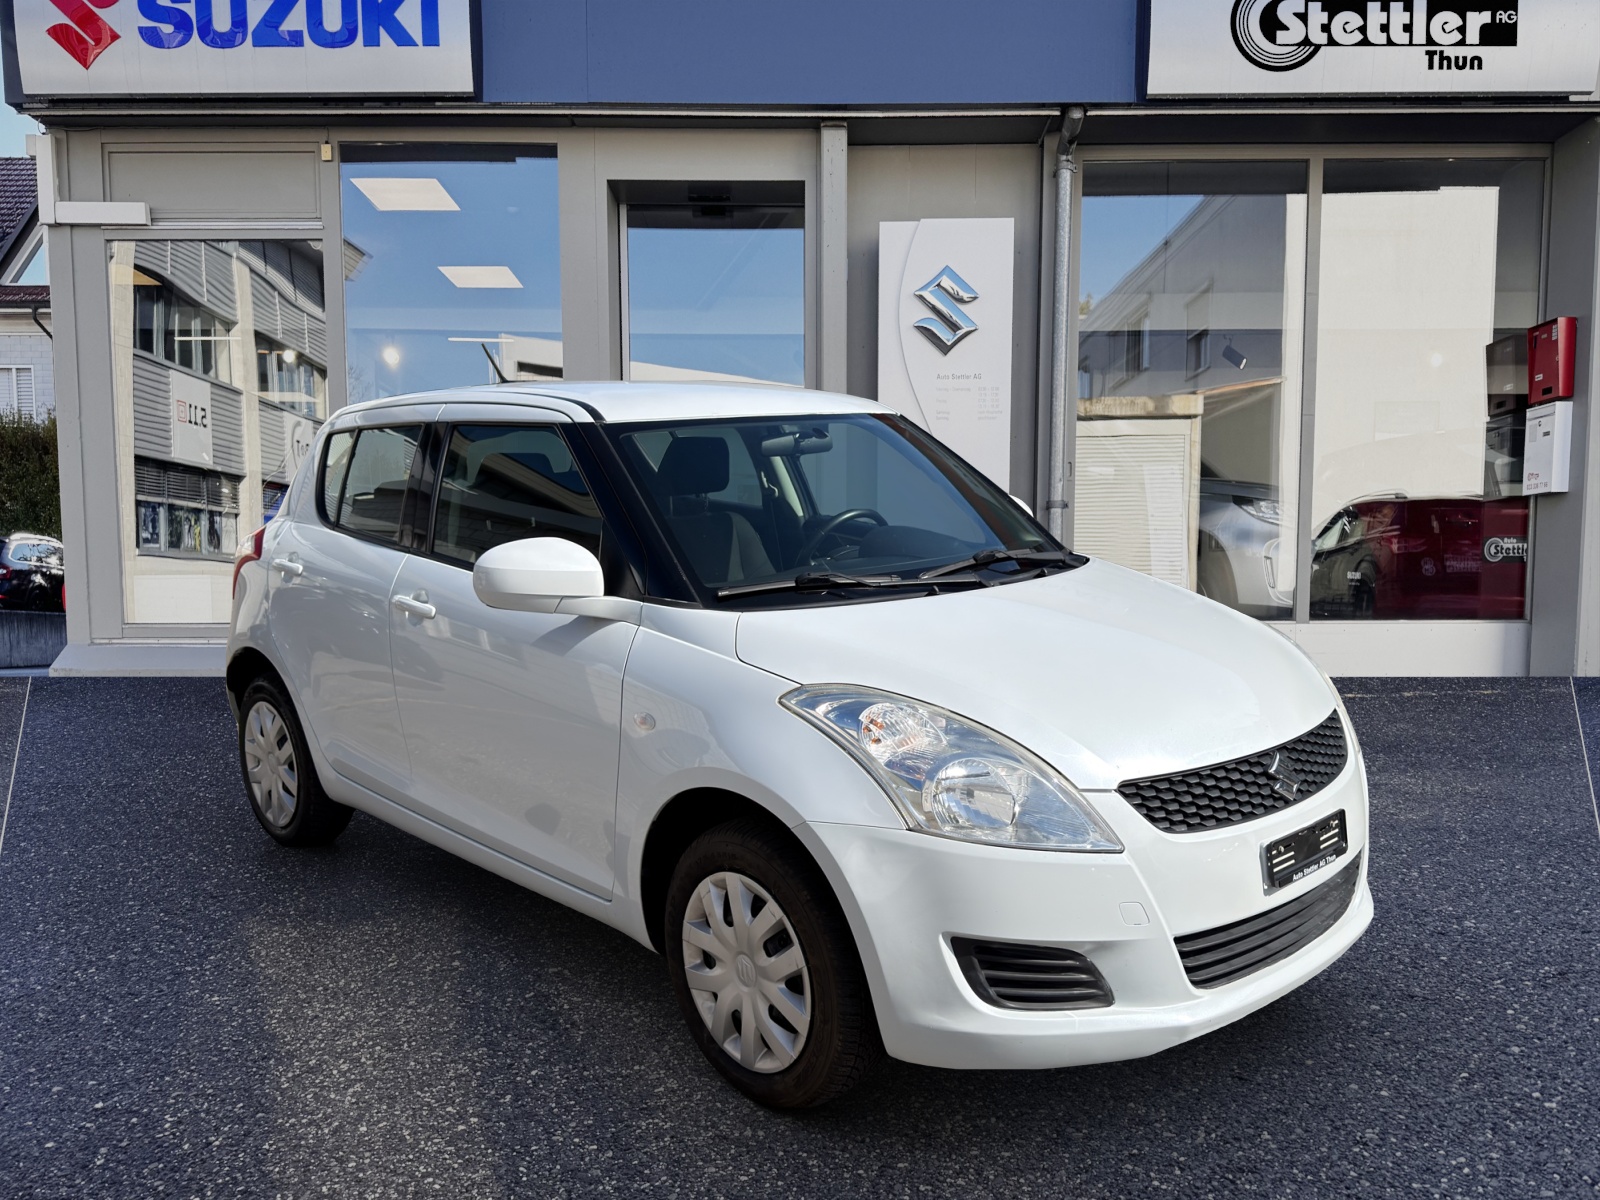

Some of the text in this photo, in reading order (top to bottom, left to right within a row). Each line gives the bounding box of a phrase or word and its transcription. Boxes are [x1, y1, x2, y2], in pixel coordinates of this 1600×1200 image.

[138, 0, 440, 49] SUZUKI
[1276, 0, 1518, 45] Stettler AG
[1425, 50, 1483, 71] Thun
[1293, 854, 1337, 881] Auto Stettler AG Thun
